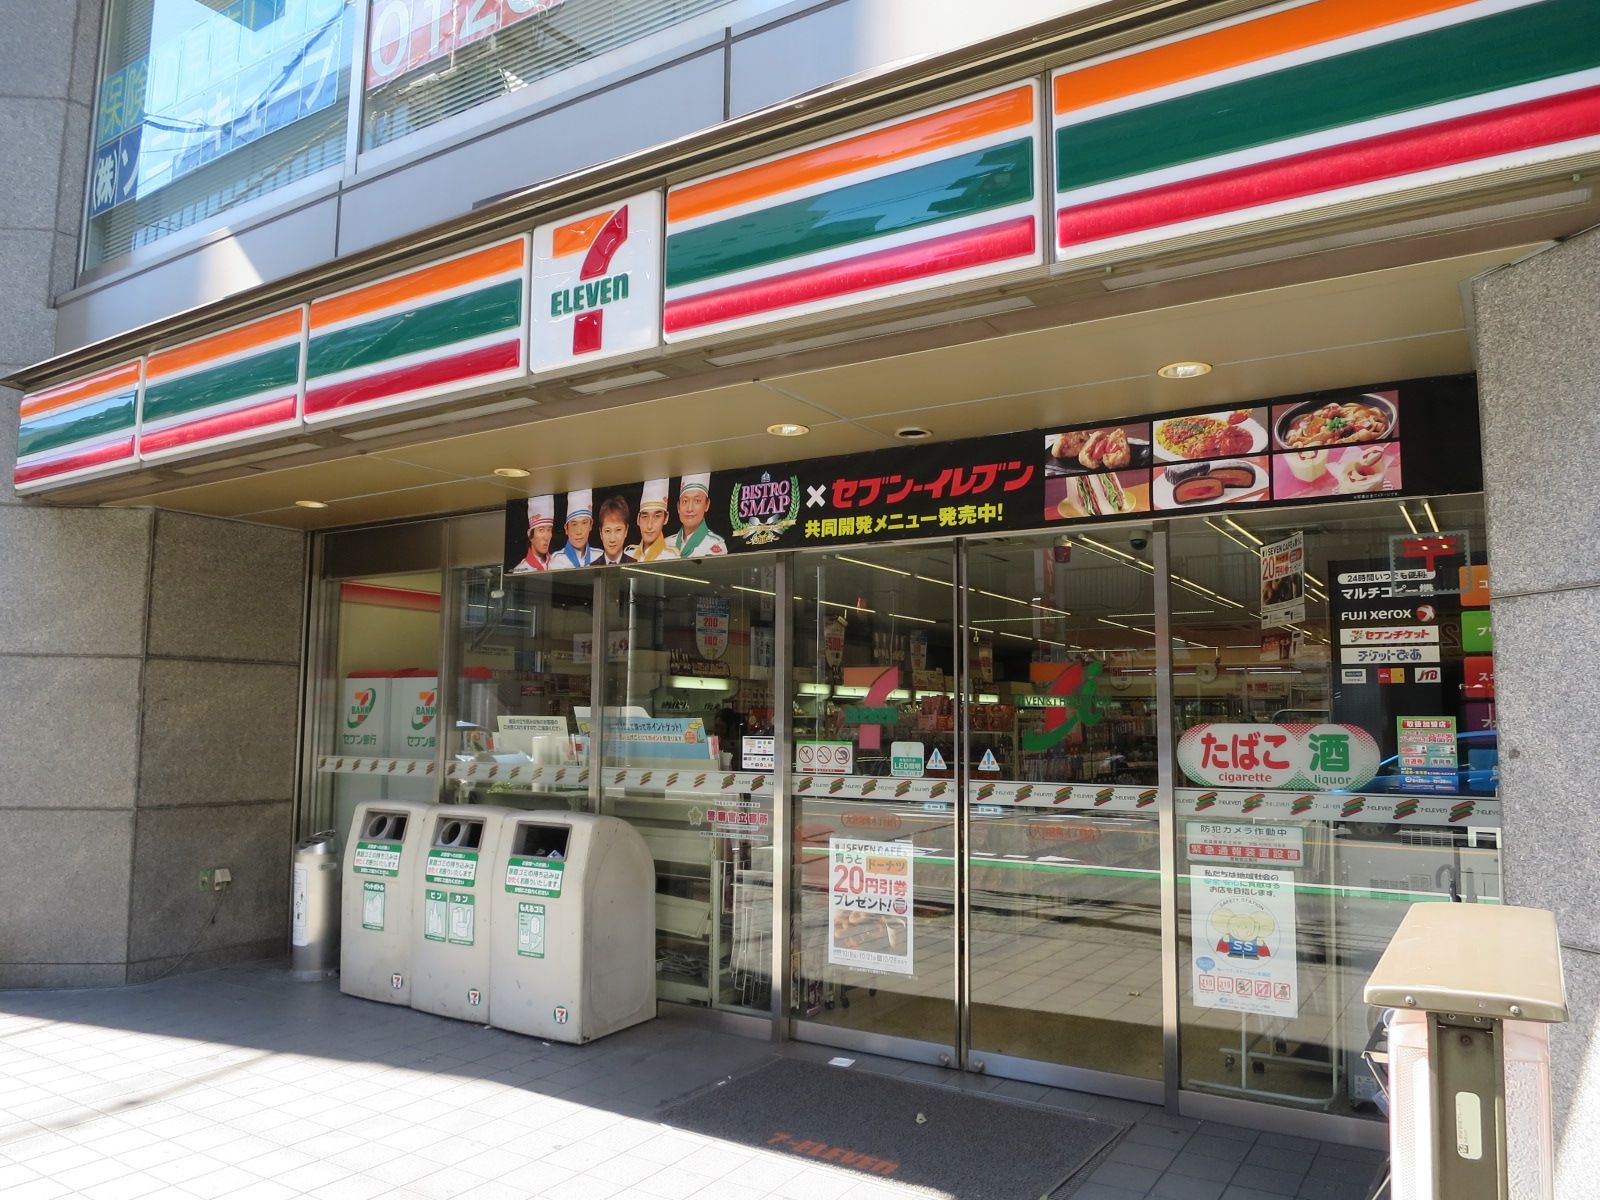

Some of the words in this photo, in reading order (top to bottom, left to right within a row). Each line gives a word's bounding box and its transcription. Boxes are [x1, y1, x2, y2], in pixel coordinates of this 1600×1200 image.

[371, 0, 531, 77] 012
[741, 480, 790, 500] BISTRO
[739, 495, 791, 517] SMAP
[805, 503, 1003, 538] 共同開発メニュー発売中!
[1341, 584, 1434, 600] マルチコピー機
[1341, 611, 1367, 621] FUJI
[1365, 629, 1430, 640] セブンチケット
[1358, 647, 1422, 662] チケットぴあ
[407, 736, 437, 747] セブン銀
[1201, 731, 1290, 770] たばこ
[1308, 733, 1350, 772] 酒
[1218, 772, 1273, 783] cigarette
[1314, 774, 1351, 785] liquor
[1200, 825, 1287, 837] 防犯カメラ作動中
[846, 843, 876, 853] SEVEN
[835, 853, 862, 865] 買うと
[868, 858, 905, 872] ドーナツ
[1204, 869, 1279, 881] 私たちは地域社会の
[1209, 886, 1276, 898] お店を目指します。
[834, 893, 892, 912] プレゼント!
[1233, 941, 1253, 951] SS
